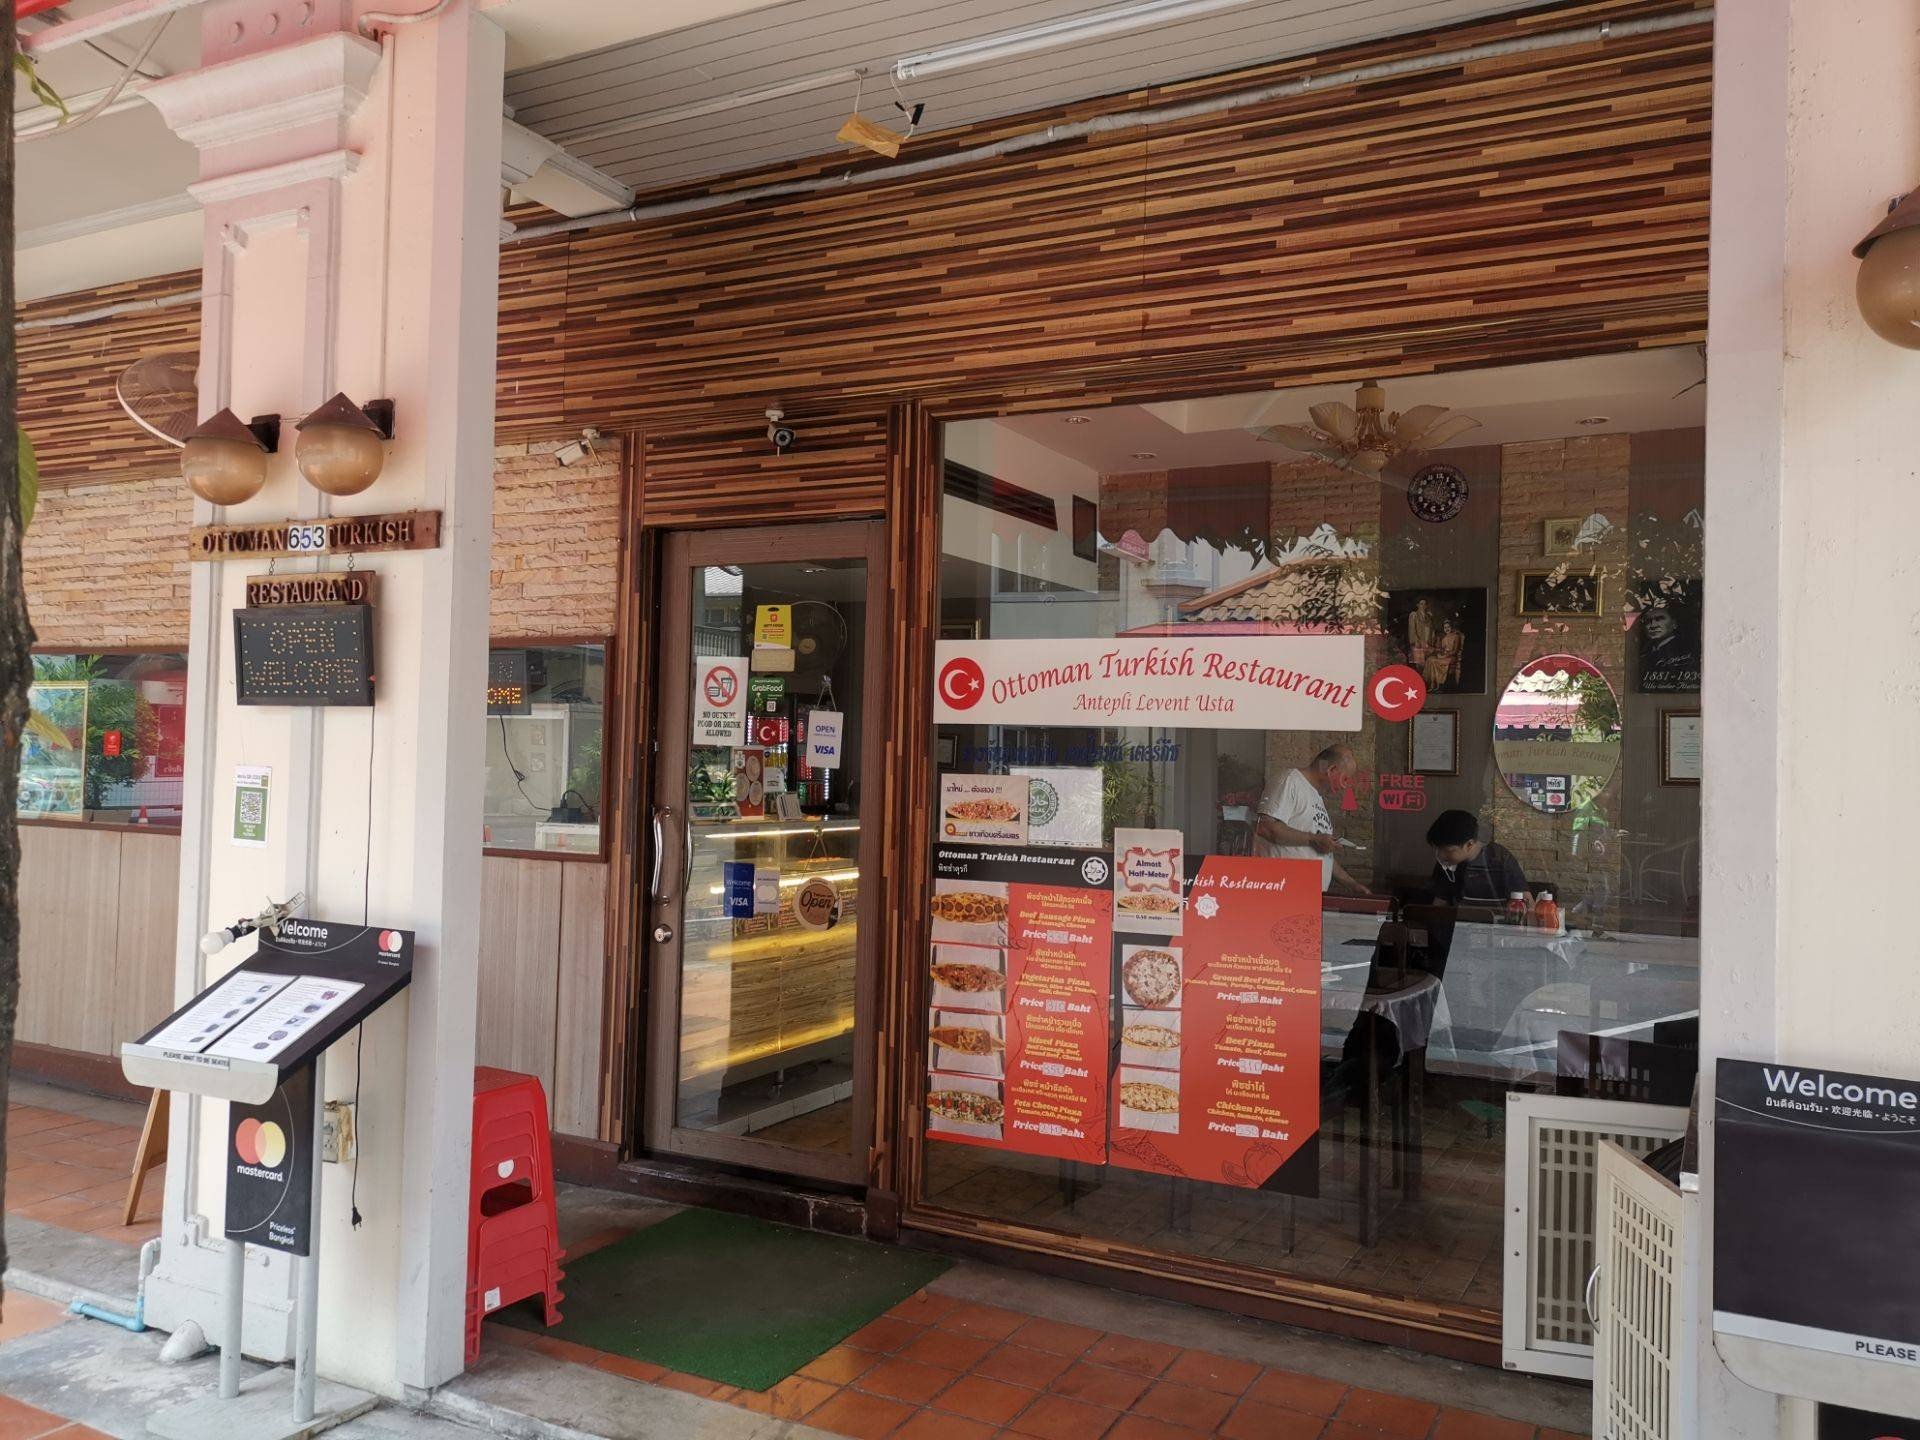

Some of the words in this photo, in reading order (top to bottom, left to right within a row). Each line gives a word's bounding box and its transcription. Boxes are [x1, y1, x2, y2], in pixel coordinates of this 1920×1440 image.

[289, 526, 325, 550] 653
[249, 579, 363, 605] RESTAURAND
[270, 627, 335, 654] OPEN
[992, 661, 1092, 704] Ottoman
[1099, 647, 1194, 679] Turkish
[1202, 652, 1357, 709] Restaurant
[752, 684, 783, 692] GrabFood
[1072, 691, 1131, 717] Antepli
[1135, 693, 1190, 711] Levent
[1195, 694, 1235, 712] Usta
[697, 720, 713, 728] FOOD
[714, 720, 721, 728] OR
[722, 721, 741, 729] DRINK
[815, 725, 835, 733] OPEN
[705, 729, 732, 738] ALLOWED
[814, 744, 835, 755] VISA
[1380, 774, 1425, 788] FREE
[939, 850, 978, 860] Ottoman
[979, 852, 1018, 862] Turkish
[1020, 854, 1075, 866] Restaurant
[1136, 860, 1162, 868] Almost
[1128, 869, 1169, 878] Half-Meter
[1183, 874, 1215, 887] urkish
[1220, 875, 1286, 891] Restaurant
[729, 897, 748, 907] VISA
[802, 890, 831, 913] Open
[1023, 929, 1047, 940] Price
[1069, 933, 1093, 944] Baht
[1020, 997, 1044, 1008] Price
[1067, 1003, 1092, 1013] Baht
[1217, 992, 1241, 1001] Price
[1260, 995, 1283, 1005] Baht
[1020, 1060, 1043, 1071] Price
[1064, 1066, 1089, 1077] Baht
[1261, 1063, 1285, 1073] Baht
[1763, 1067, 1918, 1110] Welcome
[1216, 1101, 1253, 1112] Chicken
[1254, 1106, 1281, 1117] Pizza
[1881, 1112, 1917, 1125] ようこそ
[1013, 1120, 1039, 1130] Price
[1062, 1127, 1085, 1138] Baht
[1208, 1121, 1237, 1133] Price
[1262, 1129, 1289, 1141] Baht
[237, 1165, 284, 1182] mastercard
[1855, 1340, 1917, 1361] PLEASE
